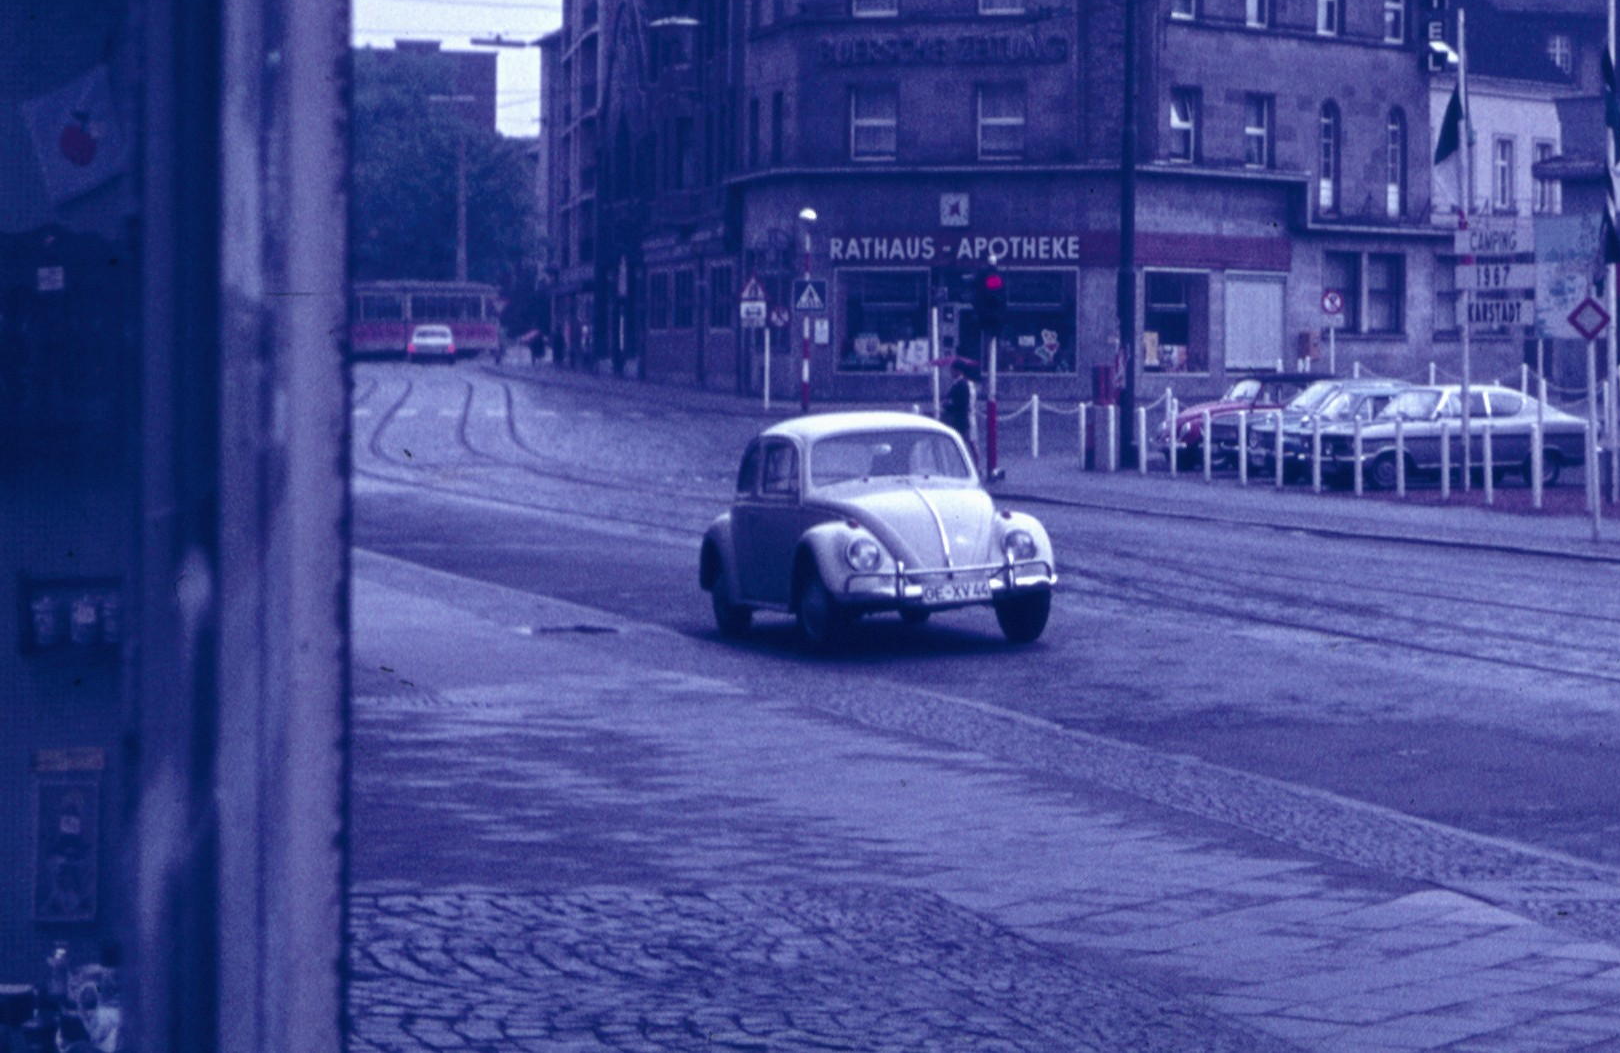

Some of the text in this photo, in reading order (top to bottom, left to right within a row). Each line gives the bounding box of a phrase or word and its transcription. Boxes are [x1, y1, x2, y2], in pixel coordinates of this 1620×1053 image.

[829, 236, 936, 260] RATHAUS
[956, 236, 1080, 260] APOTHEKE
[1469, 230, 1517, 252] CAMPING
[1477, 265, 1510, 287] 1967
[1468, 301, 1522, 323] KARSTADT
